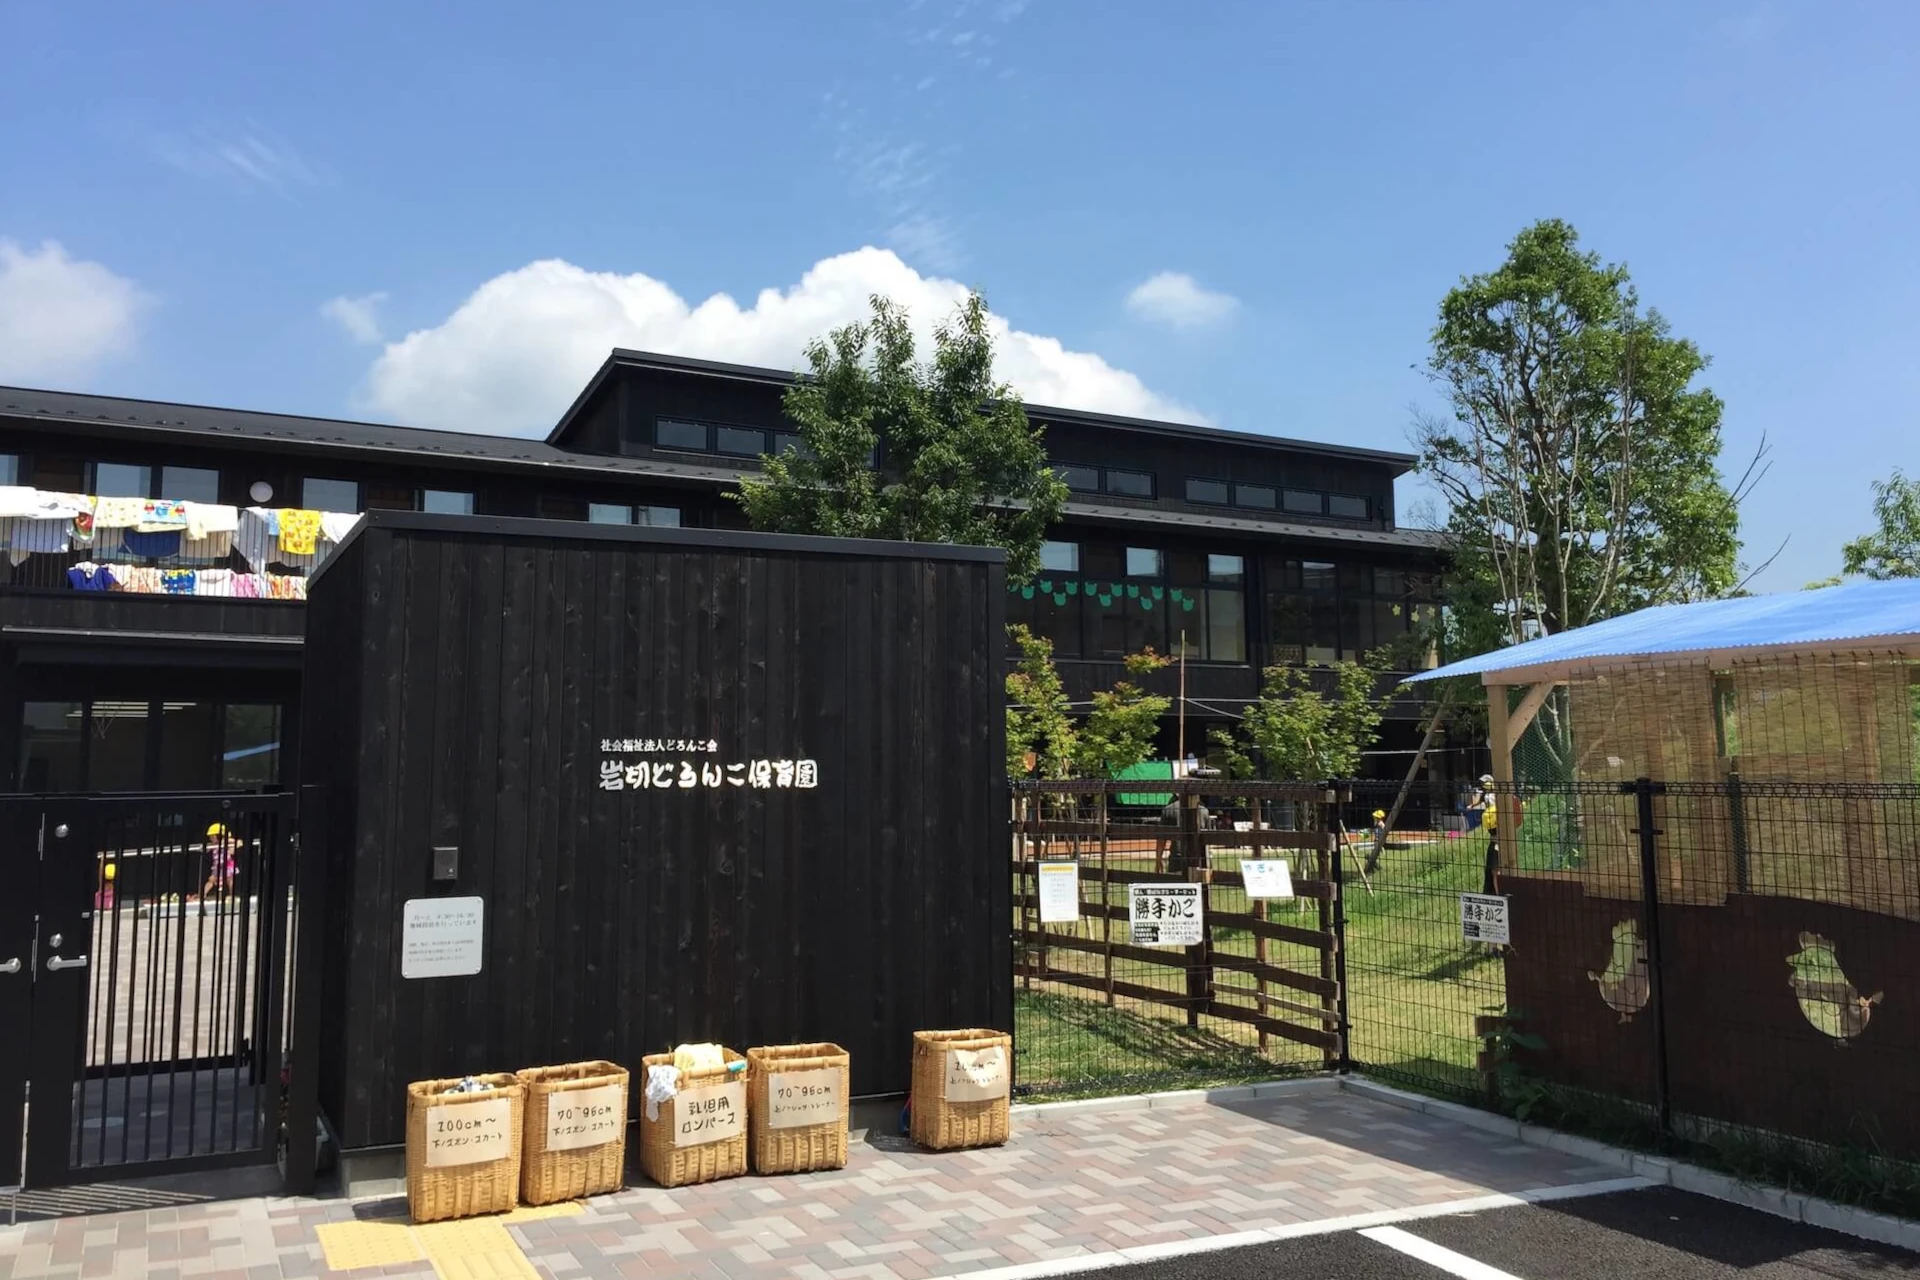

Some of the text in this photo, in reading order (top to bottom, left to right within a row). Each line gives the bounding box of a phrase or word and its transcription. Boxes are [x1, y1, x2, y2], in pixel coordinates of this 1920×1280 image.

[601, 739, 718, 752] 社会福祉法人どろんこ会
[600, 759, 818, 791] 岩切どろんこ保育園
[1135, 897, 1196, 919] 勝手かご
[689, 1096, 729, 1115] 乳児用
[682, 1112, 735, 1133] ロンパース
